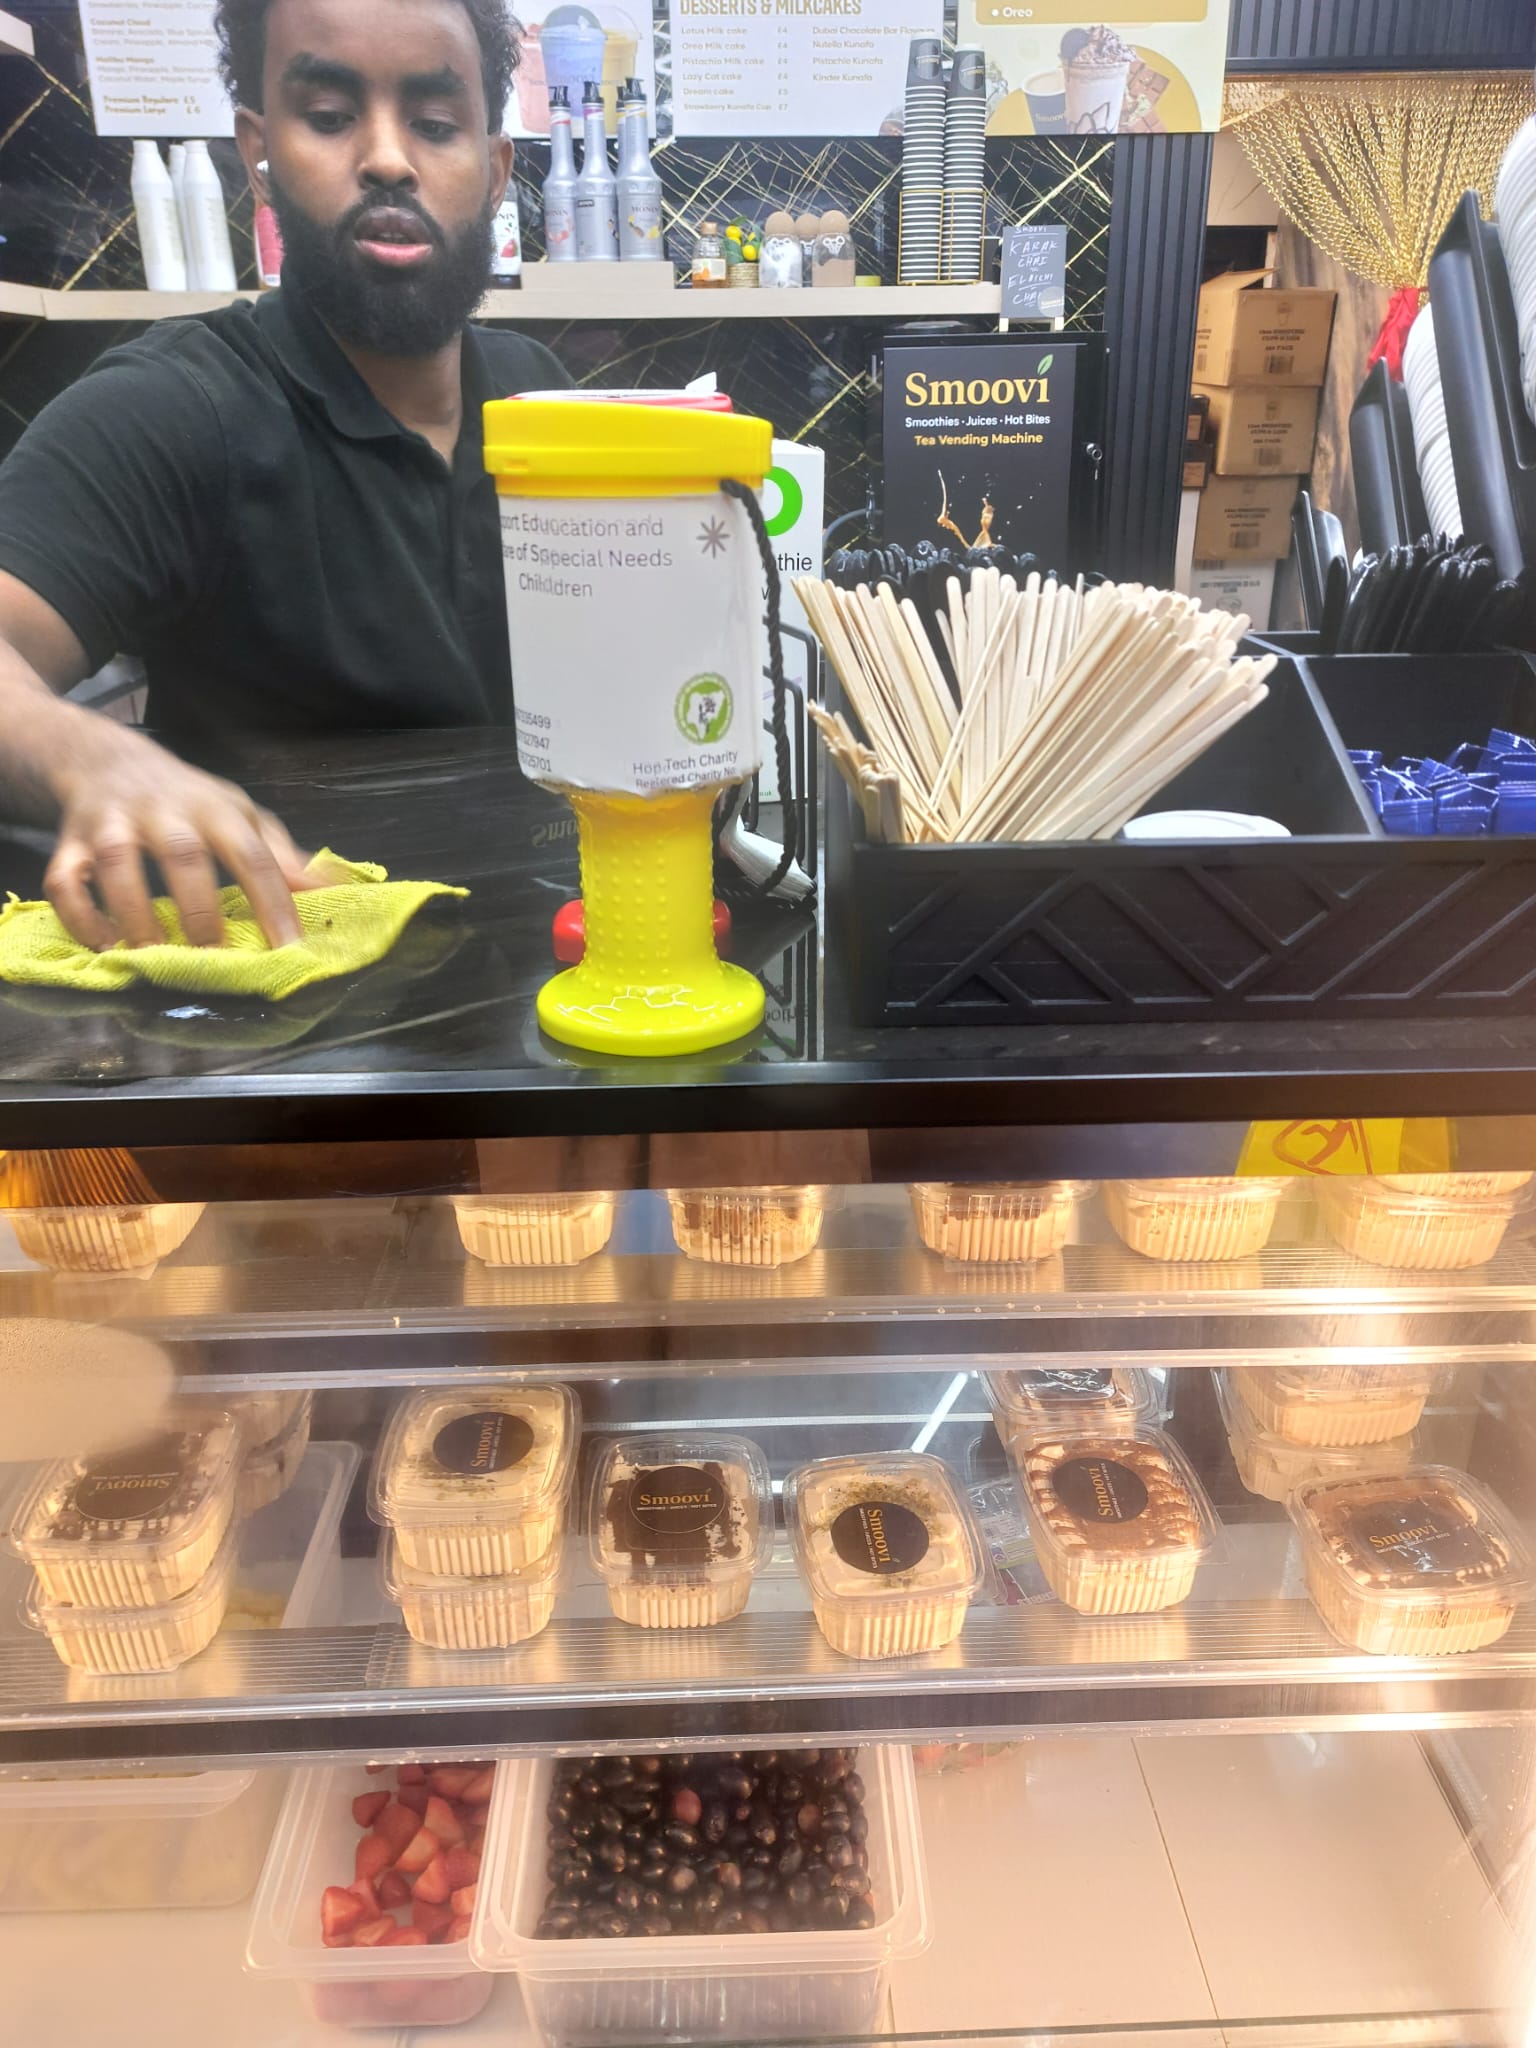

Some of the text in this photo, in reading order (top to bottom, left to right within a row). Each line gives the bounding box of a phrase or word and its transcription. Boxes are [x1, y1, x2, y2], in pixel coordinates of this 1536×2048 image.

[680, 0, 861, 15] DESSERTS & MILKCAKES
[1002, 7, 1033, 17] Oreo
[682, 27, 748, 36] Lotus Milk cake
[812, 26, 838, 35] Dubai
[839, 26, 882, 35] Chocolate
[883, 26, 898, 35] Bar
[682, 42, 746, 50] Oreo Milk cake
[843, 40, 875, 48] Kunafa
[682, 57, 765, 65] Pistachio Milk cake
[812, 57, 851, 65] Pistachio
[682, 73, 702, 82] Lazy
[812, 73, 873, 81] Kinder Kunafa
[683, 88, 712, 96] Dream
[1009, 240, 1058, 256] KARAK
[1017, 256, 1048, 268] CHAI
[905, 371, 1050, 407] Smoovi
[905, 413, 1051, 428] Smoothies Juices Hot Bites
[914, 432, 1044, 447] Tea Vending Machine
[609, 548, 673, 567] Needs
[777, 552, 812, 571] thie
[665, 756, 696, 772] Tech
[699, 750, 738, 767] Charity
[687, 769, 722, 783] Charity
[471, 1420, 496, 1467] Smoovi
[1089, 1466, 1114, 1517] Smoovi
[640, 1493, 711, 1506] Smoovi
[867, 1508, 892, 1563] Smoovi
[1369, 1524, 1438, 1548] Smoovi
